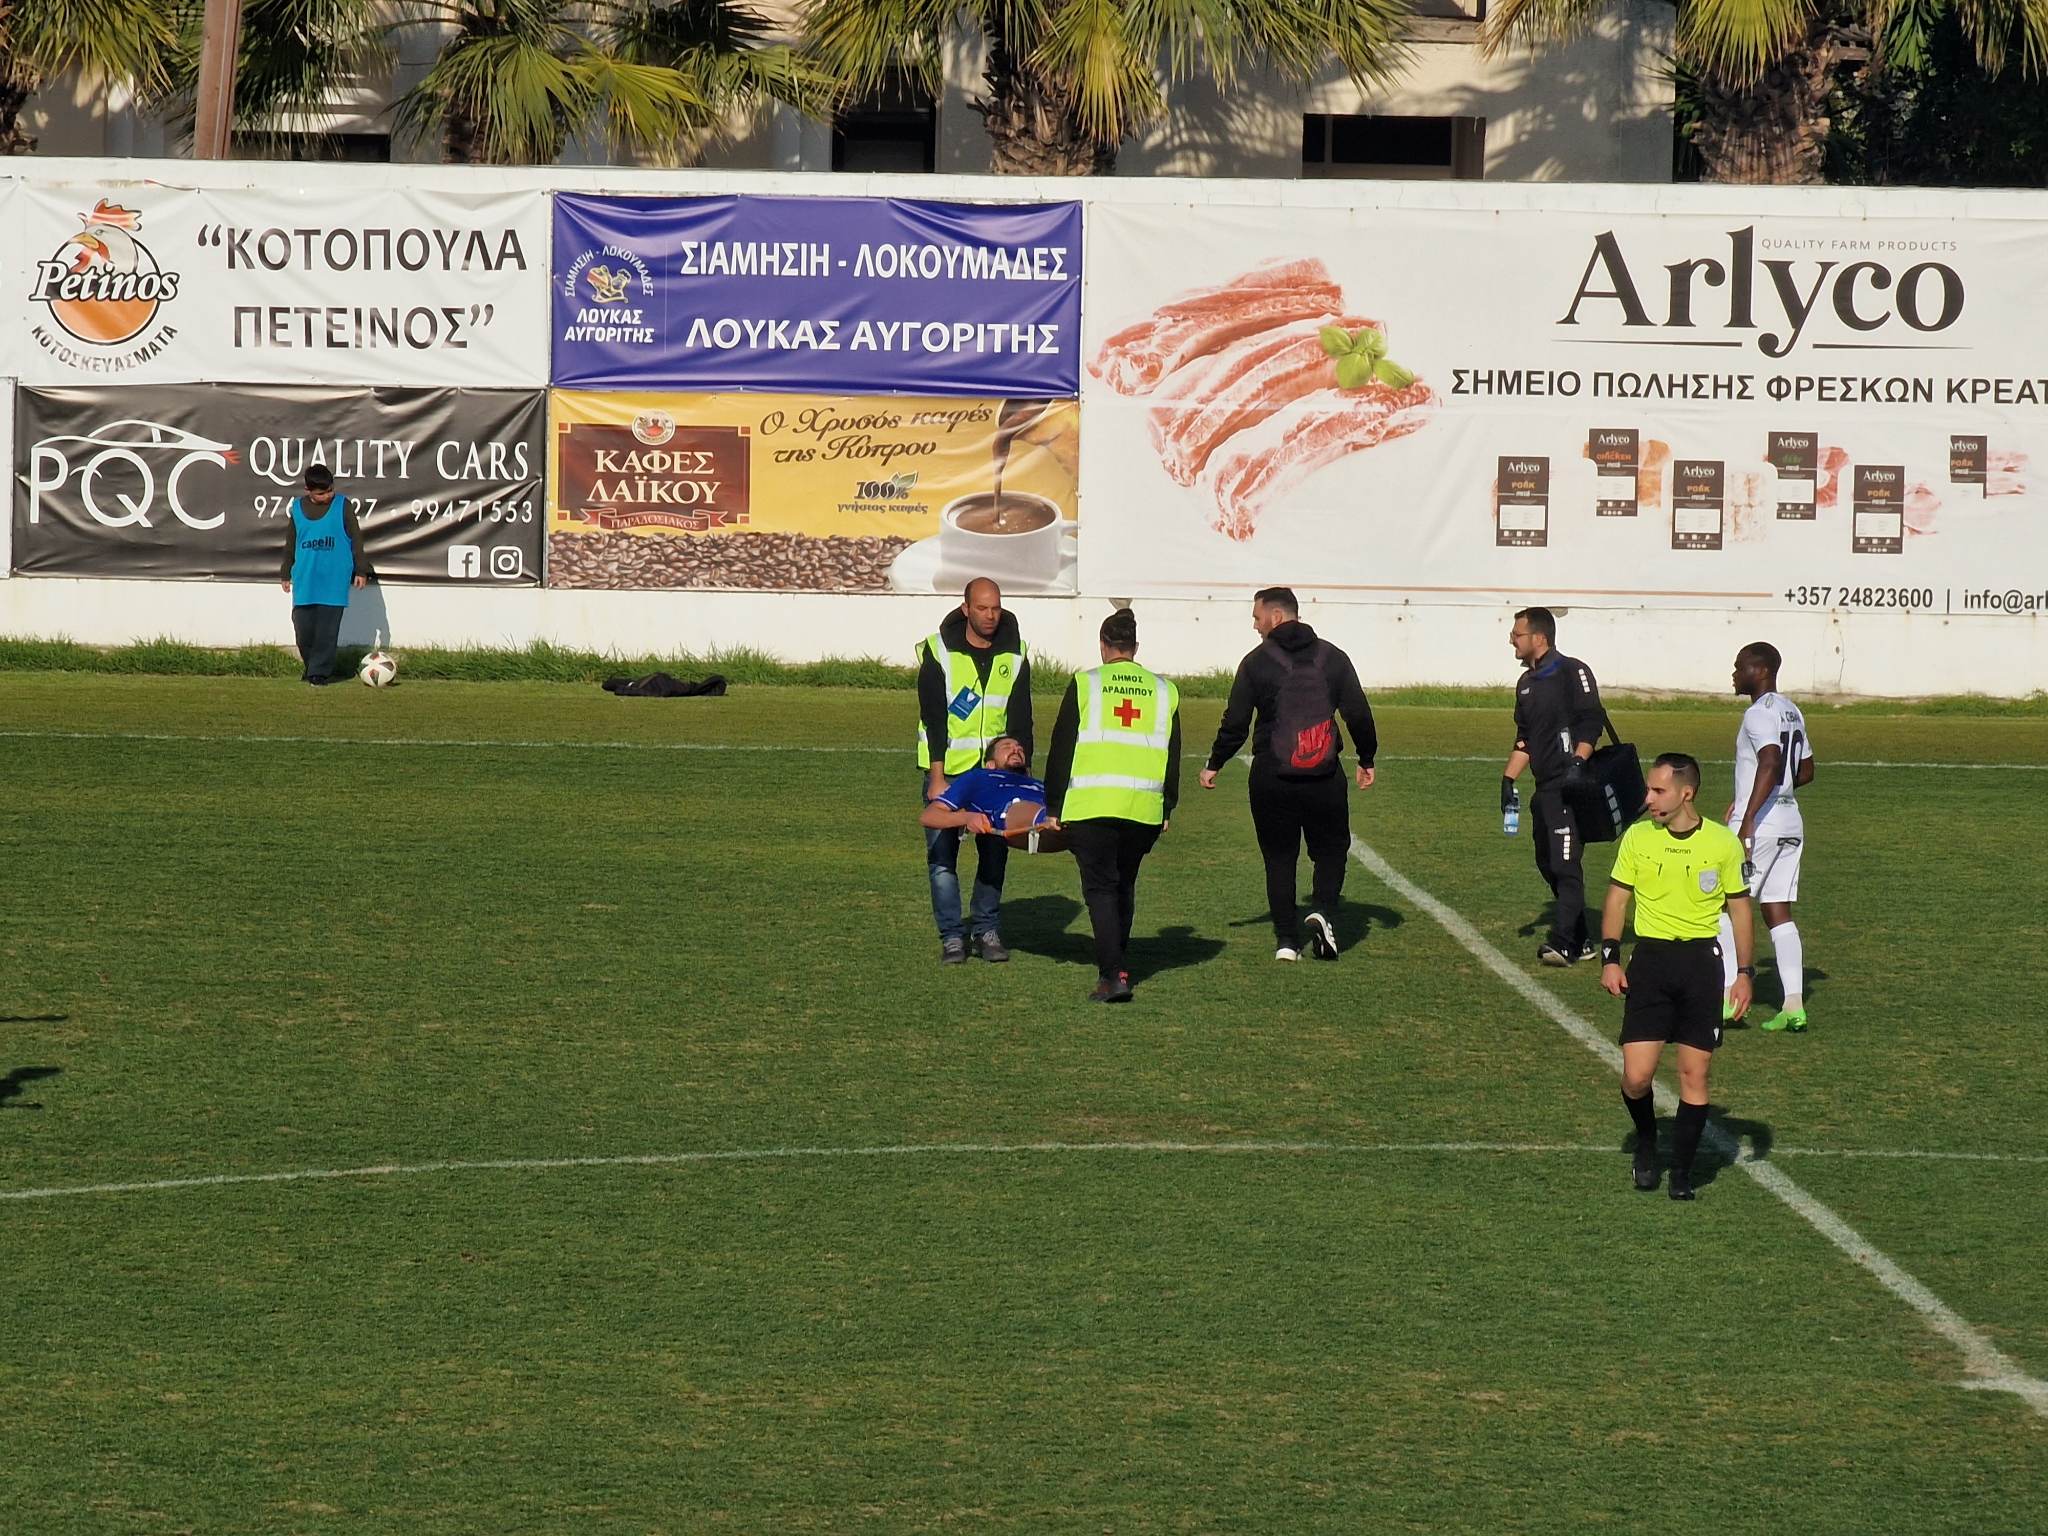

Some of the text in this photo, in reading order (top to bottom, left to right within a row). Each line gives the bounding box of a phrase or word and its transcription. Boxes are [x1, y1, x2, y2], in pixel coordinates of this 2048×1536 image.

[1761, 238, 1958, 251] QUALITY FARM PRODUCTS
[680, 241, 830, 277] ΣΙΑΜΗΣΙΗ
[853, 243, 1068, 281] ΛΟΚΟΥΜΑΔΕΣ
[29, 260, 180, 302] Petinos
[1555, 224, 1965, 359] Arlyco
[576, 308, 643, 325] ΛΟΥΚΑΣ
[564, 326, 655, 343] ΑΥΓΟΡΙΤΗΣ
[686, 318, 1059, 355] ΛΟΥΚΑΣ ΑΥΓΟΡΙΤΗΣ
[1451, 369, 1581, 397] ΣΗΜΕΙΟ
[1592, 371, 1755, 401] ΠΩΛΗΣΗΣ
[1766, 374, 1934, 403] ΦΡΕΣΚΩΝ
[1598, 433, 1630, 446] Arlyco
[1777, 437, 1809, 449] Arlyco
[249, 436, 529, 487] QUALITY CARS
[594, 449, 715, 474] ΚΑΦΕΣ
[1507, 461, 1540, 474] Arlyco
[1683, 466, 1715, 478] Arlyco
[1863, 470, 1896, 482] Arlyco
[30, 446, 226, 530] PQC
[586, 475, 721, 504] ΛΑΪΚΟΥ
[411, 499, 533, 524] 99471553
[610, 515, 700, 530] ΠΑΡΑΔΟΣΙΑΚΟΣ
[1784, 586, 1832, 606] +357
[1838, 587, 1933, 608] 24823600
[1112, 674, 1143, 684] ΔΗΜΟΣ
[1102, 686, 1153, 697] ΑΡΑΔΙΠΠΟΥ
[1777, 729, 1804, 789] 10
